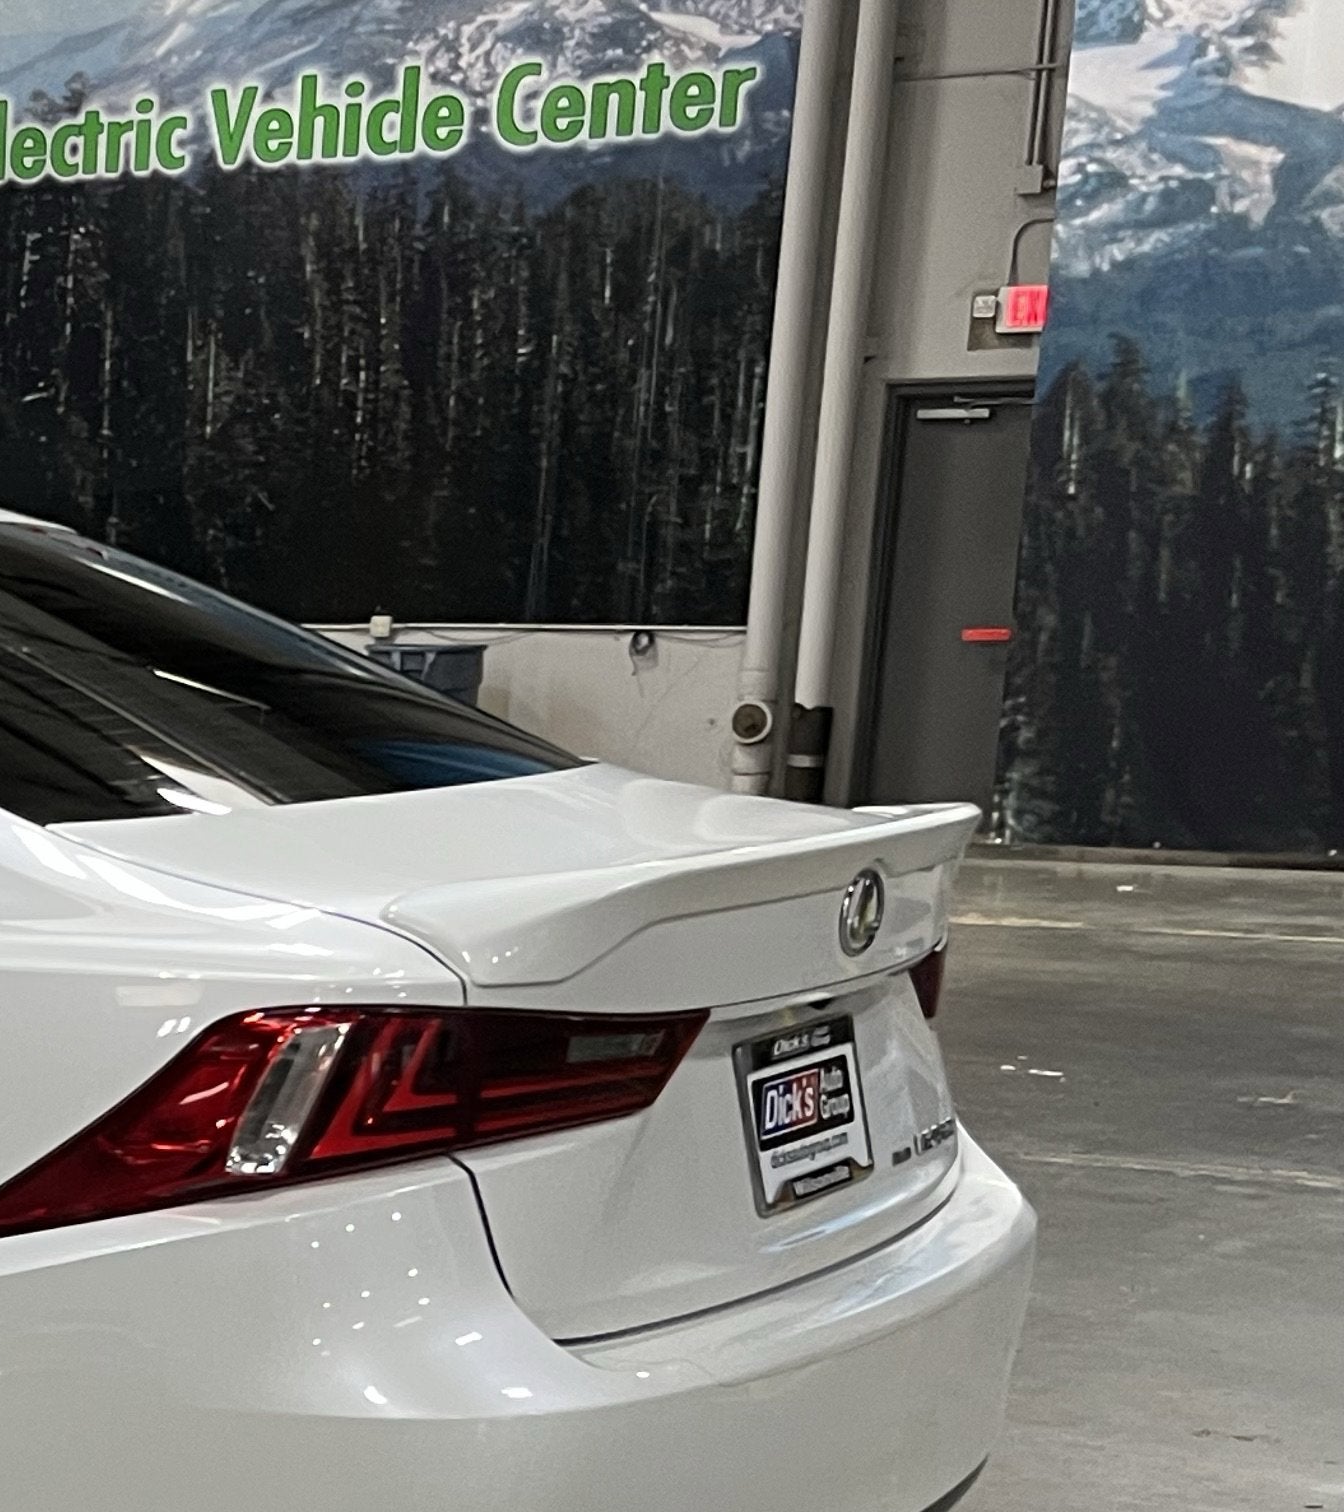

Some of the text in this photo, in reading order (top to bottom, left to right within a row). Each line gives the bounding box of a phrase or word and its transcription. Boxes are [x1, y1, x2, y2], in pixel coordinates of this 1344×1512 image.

[210, 66, 465, 167] Vehicle
[496, 61, 758, 149] Center
[765, 1066, 843, 1130] Dick's Auto
[819, 1093, 850, 1119] Group
